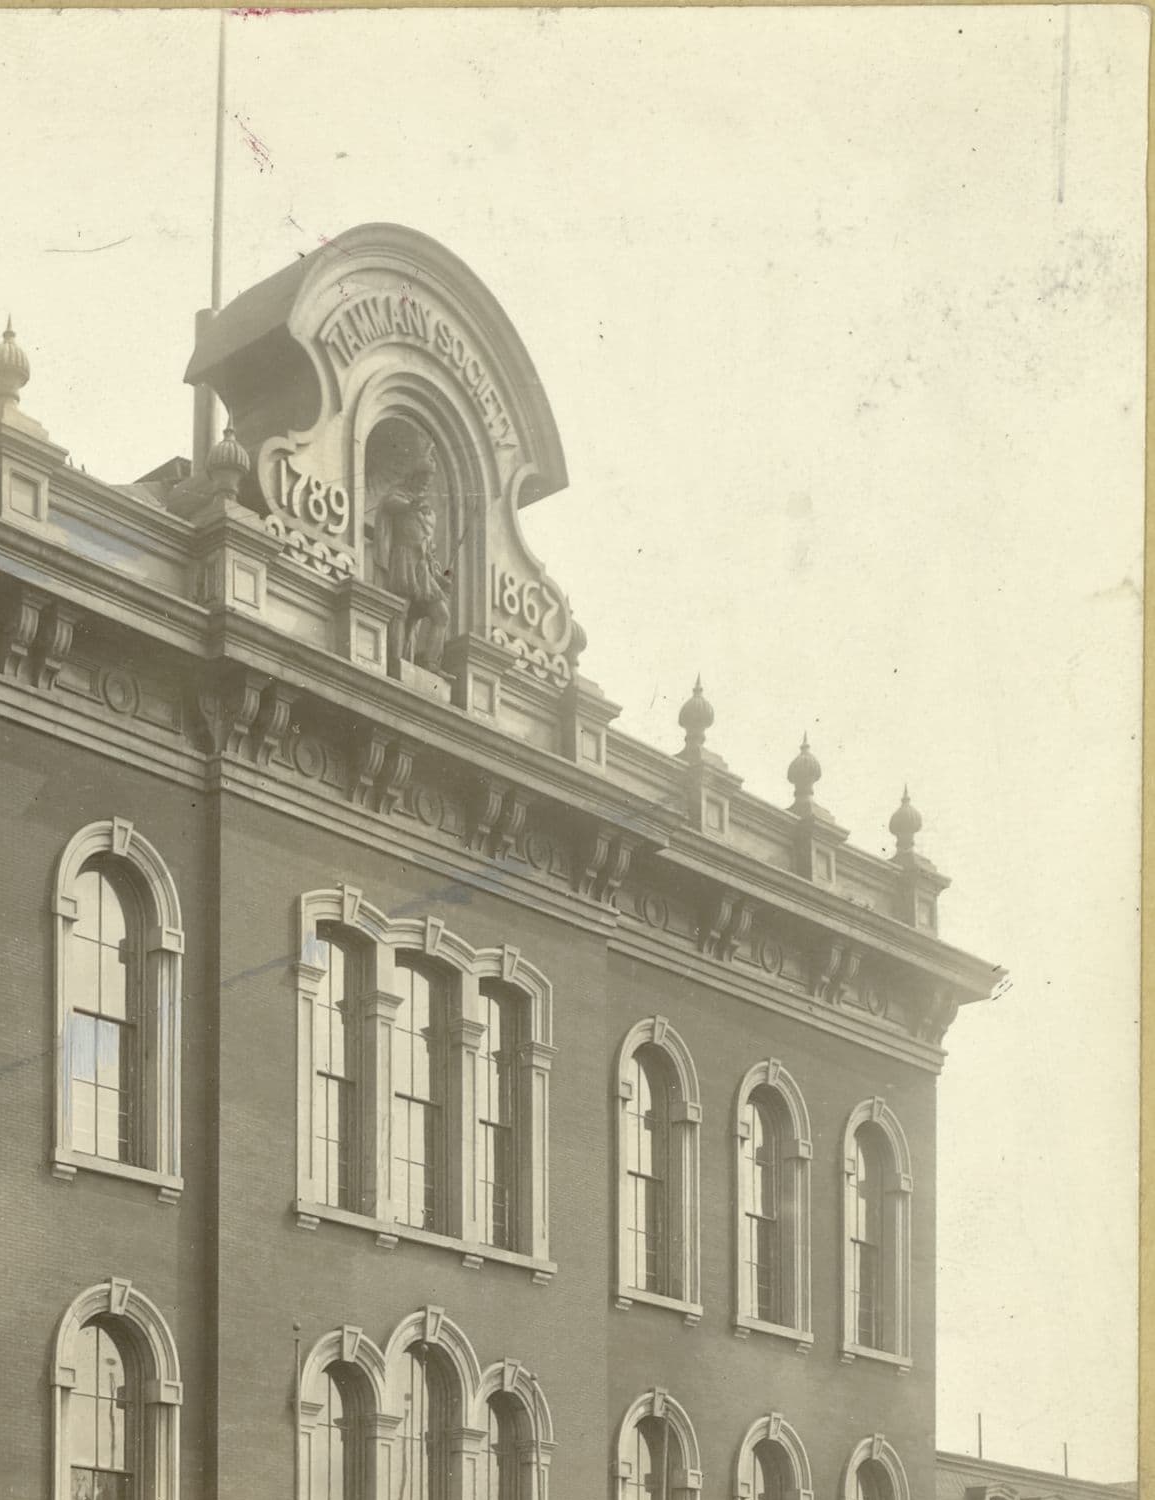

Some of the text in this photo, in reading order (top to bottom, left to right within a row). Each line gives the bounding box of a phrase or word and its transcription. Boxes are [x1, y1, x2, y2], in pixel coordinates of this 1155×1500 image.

[325, 295, 518, 450] TAMMANY SOCIETY
[280, 458, 349, 534] 1789
[491, 563, 559, 641] 1867
